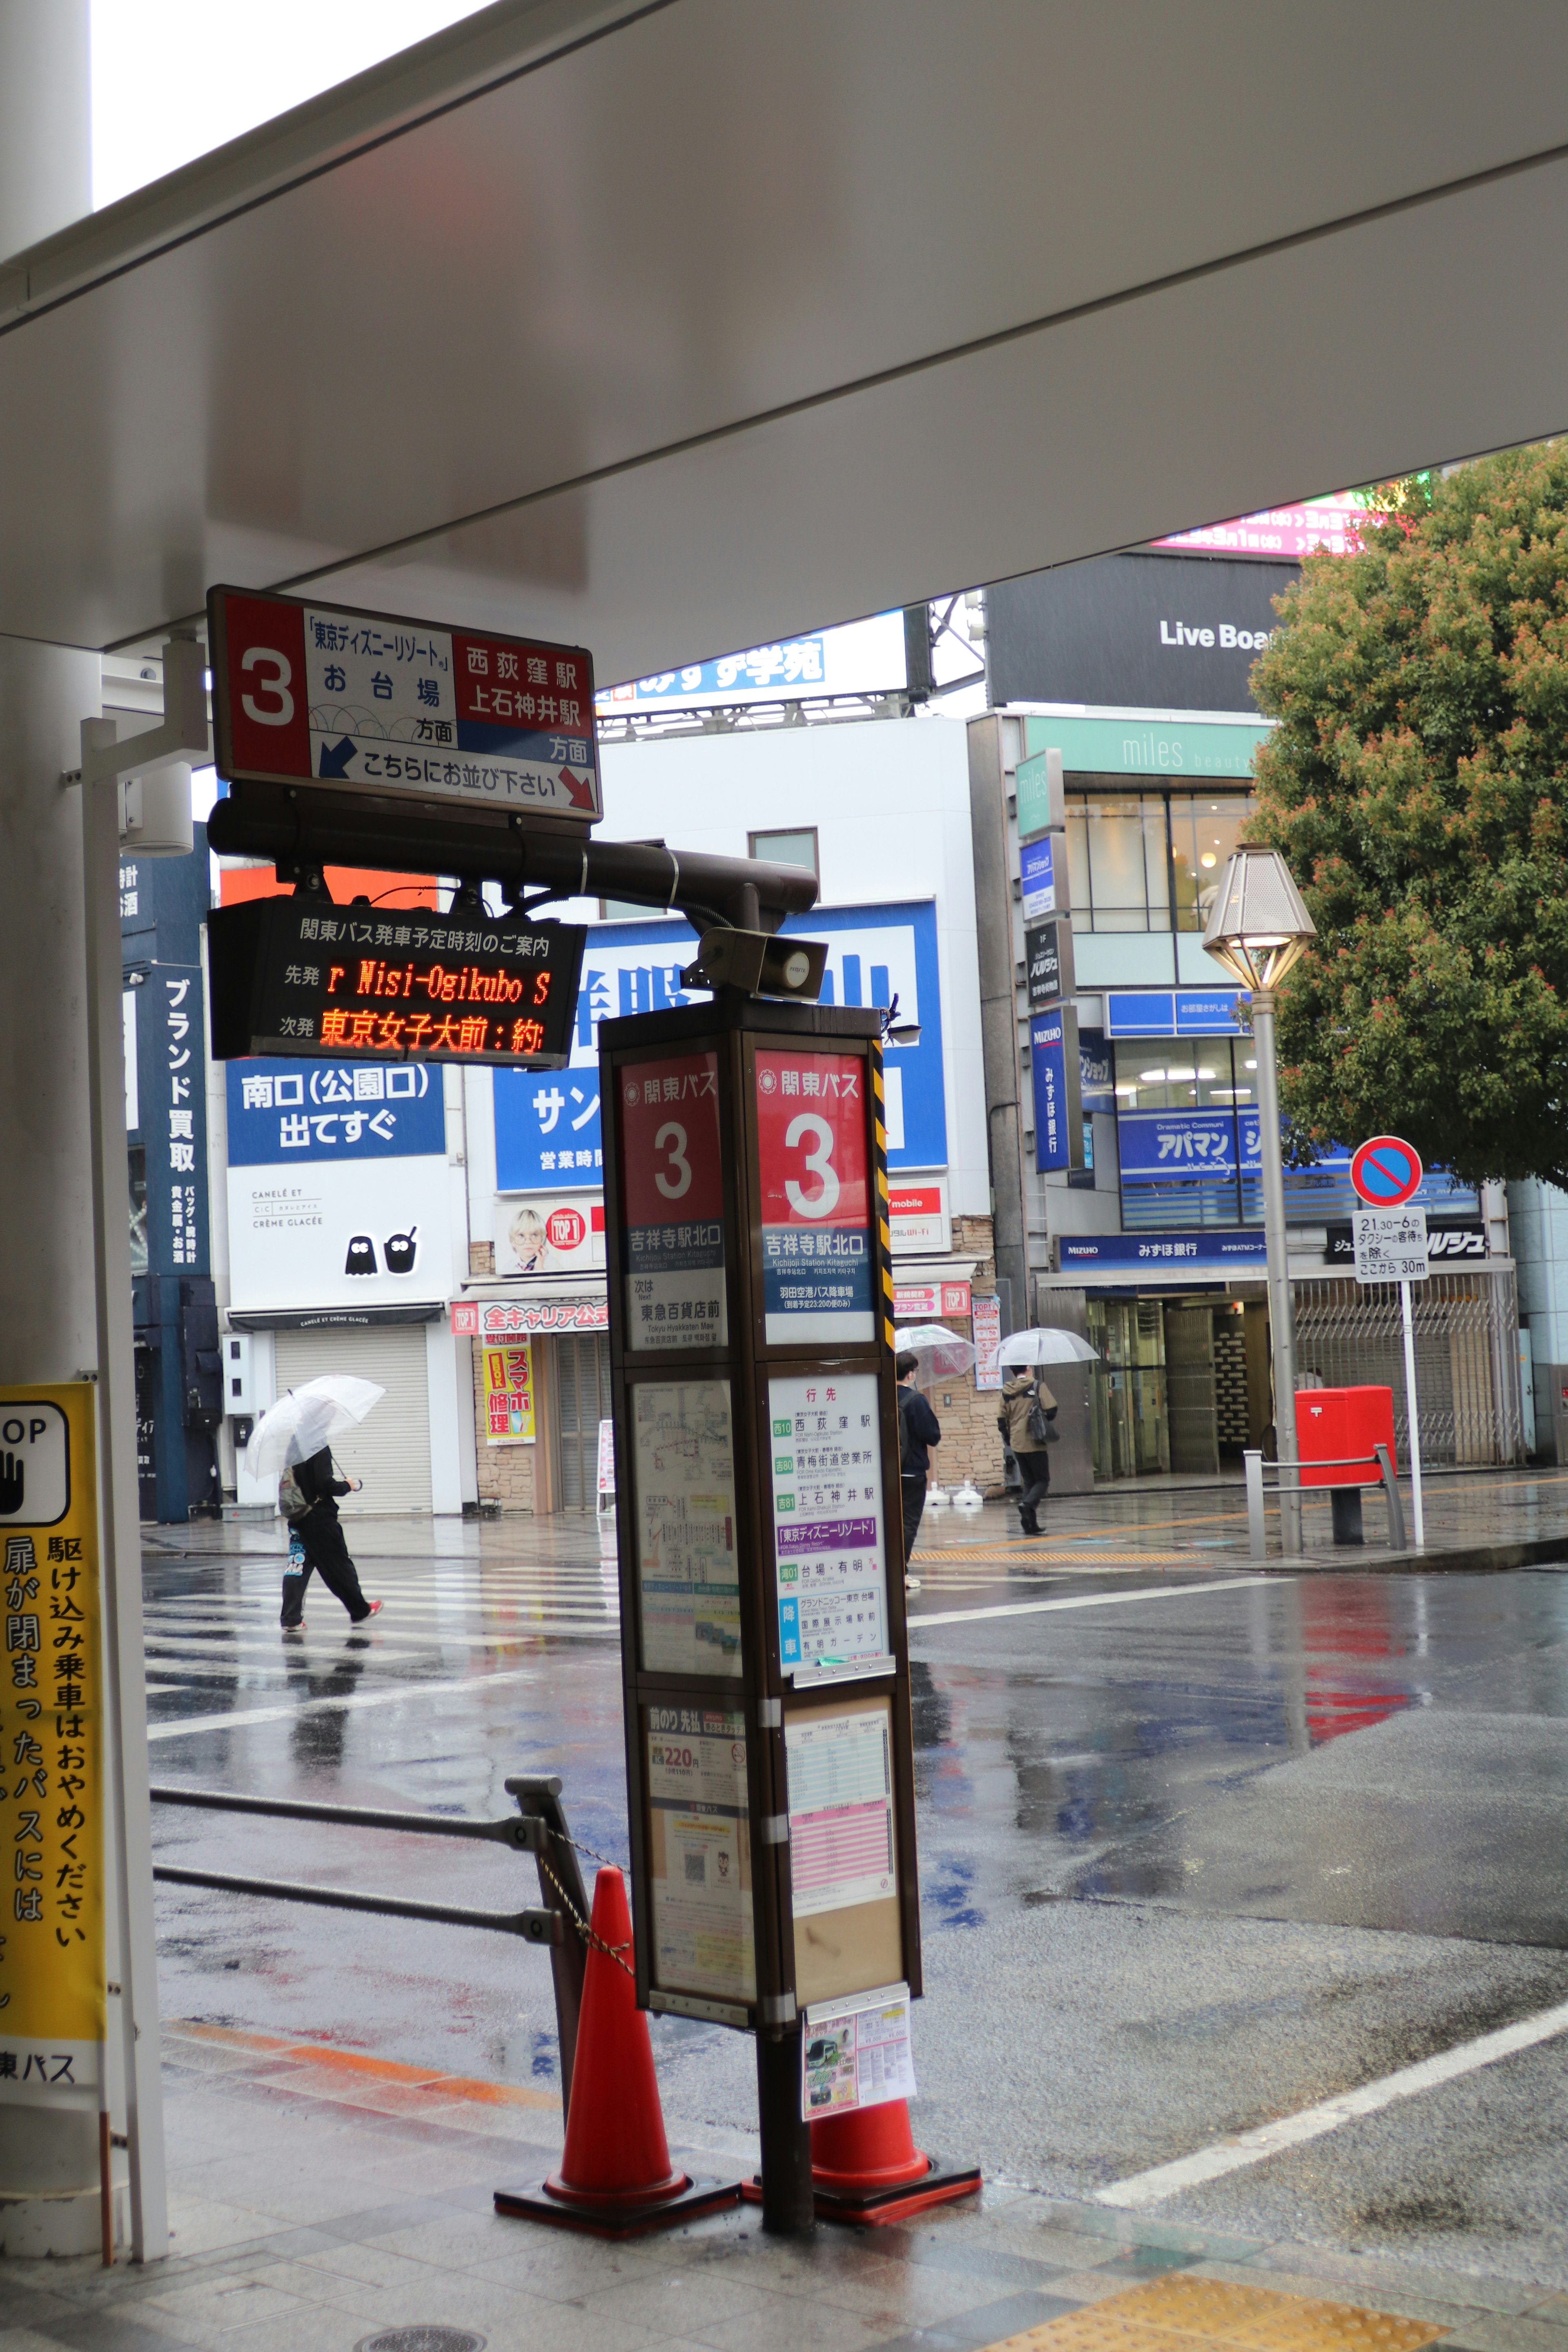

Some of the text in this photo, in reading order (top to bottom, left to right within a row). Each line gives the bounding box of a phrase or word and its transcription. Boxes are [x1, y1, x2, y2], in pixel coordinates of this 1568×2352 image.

[1160, 620, 1276, 650] Live Boa
[467, 646, 577, 690] 西荻窪駅
[241, 647, 294, 726] 3
[324, 664, 440, 708] お台場
[469, 684, 581, 727] 上石神井駅
[416, 717, 452, 743] 方面
[549, 736, 588, 764] 方面
[1123, 732, 1183, 767] miles
[363, 753, 555, 797] こちらにお並び下さい
[1021, 768, 1047, 804] miles
[299, 918, 550, 958] 関東バス発車予定時刻のご案内
[1039, 934, 1047, 944] 1F
[285, 965, 319, 986] 先発
[357, 960, 523, 1002] Nisi-Ogikubo
[534, 971, 550, 1005] S
[1180, 1003, 1228, 1013] お部屋さがしは
[279, 1017, 314, 1038] 次発
[1033, 1026, 1062, 1044] MIZUHO
[166, 978, 195, 1172] ブランド買取
[782, 1071, 859, 1099] 関東バス
[241, 1064, 429, 1109] 南口(公園口)
[644, 1071, 717, 1105] 関東バス
[1045, 1067, 1058, 1154] みずほ銀行
[280, 1109, 396, 1148] 出てすぐ
[1157, 1121, 1225, 1131] Dramatic Communi
[1157, 1132, 1229, 1159] アパマン
[654, 1122, 692, 1200] 3
[784, 1113, 841, 1219] 3
[1187, 1162, 1216, 1171] NET
[252, 1188, 287, 1199] CANELÉ
[253, 1216, 323, 1228] CRÈME GLACÉE
[554, 1220, 570, 1241] TOP
[630, 1225, 722, 1252] 吉祥寺駅北口
[766, 1234, 864, 1256] 吉祥寺駅北口
[1334, 1240, 1355, 1252] ジュ
[1358, 1230, 1423, 1245] タクシーの客待ち
[636, 1250, 716, 1263] Kichijoji Station Kitaguchi
[1068, 1243, 1267, 1258] MIZUHO みずほ銀行 みずほATMコーナー
[1360, 1247, 1390, 1259] を除く
[773, 1258, 799, 1267] Kichijoji
[827, 1258, 858, 1267] Kitaguchi
[1360, 1261, 1425, 1275] ここから 30m
[635, 1279, 653, 1293] 次は
[780, 1286, 854, 1299] 羽田空港バス降車場
[784, 1300, 851, 1309] (到着予定23:20の便のみ)
[947, 1292, 960, 1307] TOP
[486, 1304, 608, 1329] 全キャリア公式
[641, 1300, 719, 1322] 東急百貨店前
[648, 1325, 666, 1333] Tokyu
[667, 1323, 699, 1332] Hyakkaten
[509, 1351, 530, 1411] スマホ
[806, 1388, 836, 1402] 行先
[489, 1393, 510, 1434] 修理
[774, 1414, 871, 1434] 西10 西荻窪駅
[776, 1451, 872, 1472] 吉80 青梅街道営業所
[778, 1487, 874, 1510] 吉81 上石神井駅
[781, 1567, 797, 1580] 湾01
[802, 1559, 863, 1578] 台場・有明
[801, 1592, 874, 1609] グランドニッコー東京 台場
[783, 1605, 797, 1656] 降車
[802, 1612, 875, 1630] 国際展示場駅前
[803, 1633, 876, 1651] 有明ガーデン
[3, 1535, 48, 1922] 扉が閉まったバスには
[650, 1706, 701, 1733] 前のり 先払
[47, 1536, 86, 1947] 駆け込み乗車はおやめください
